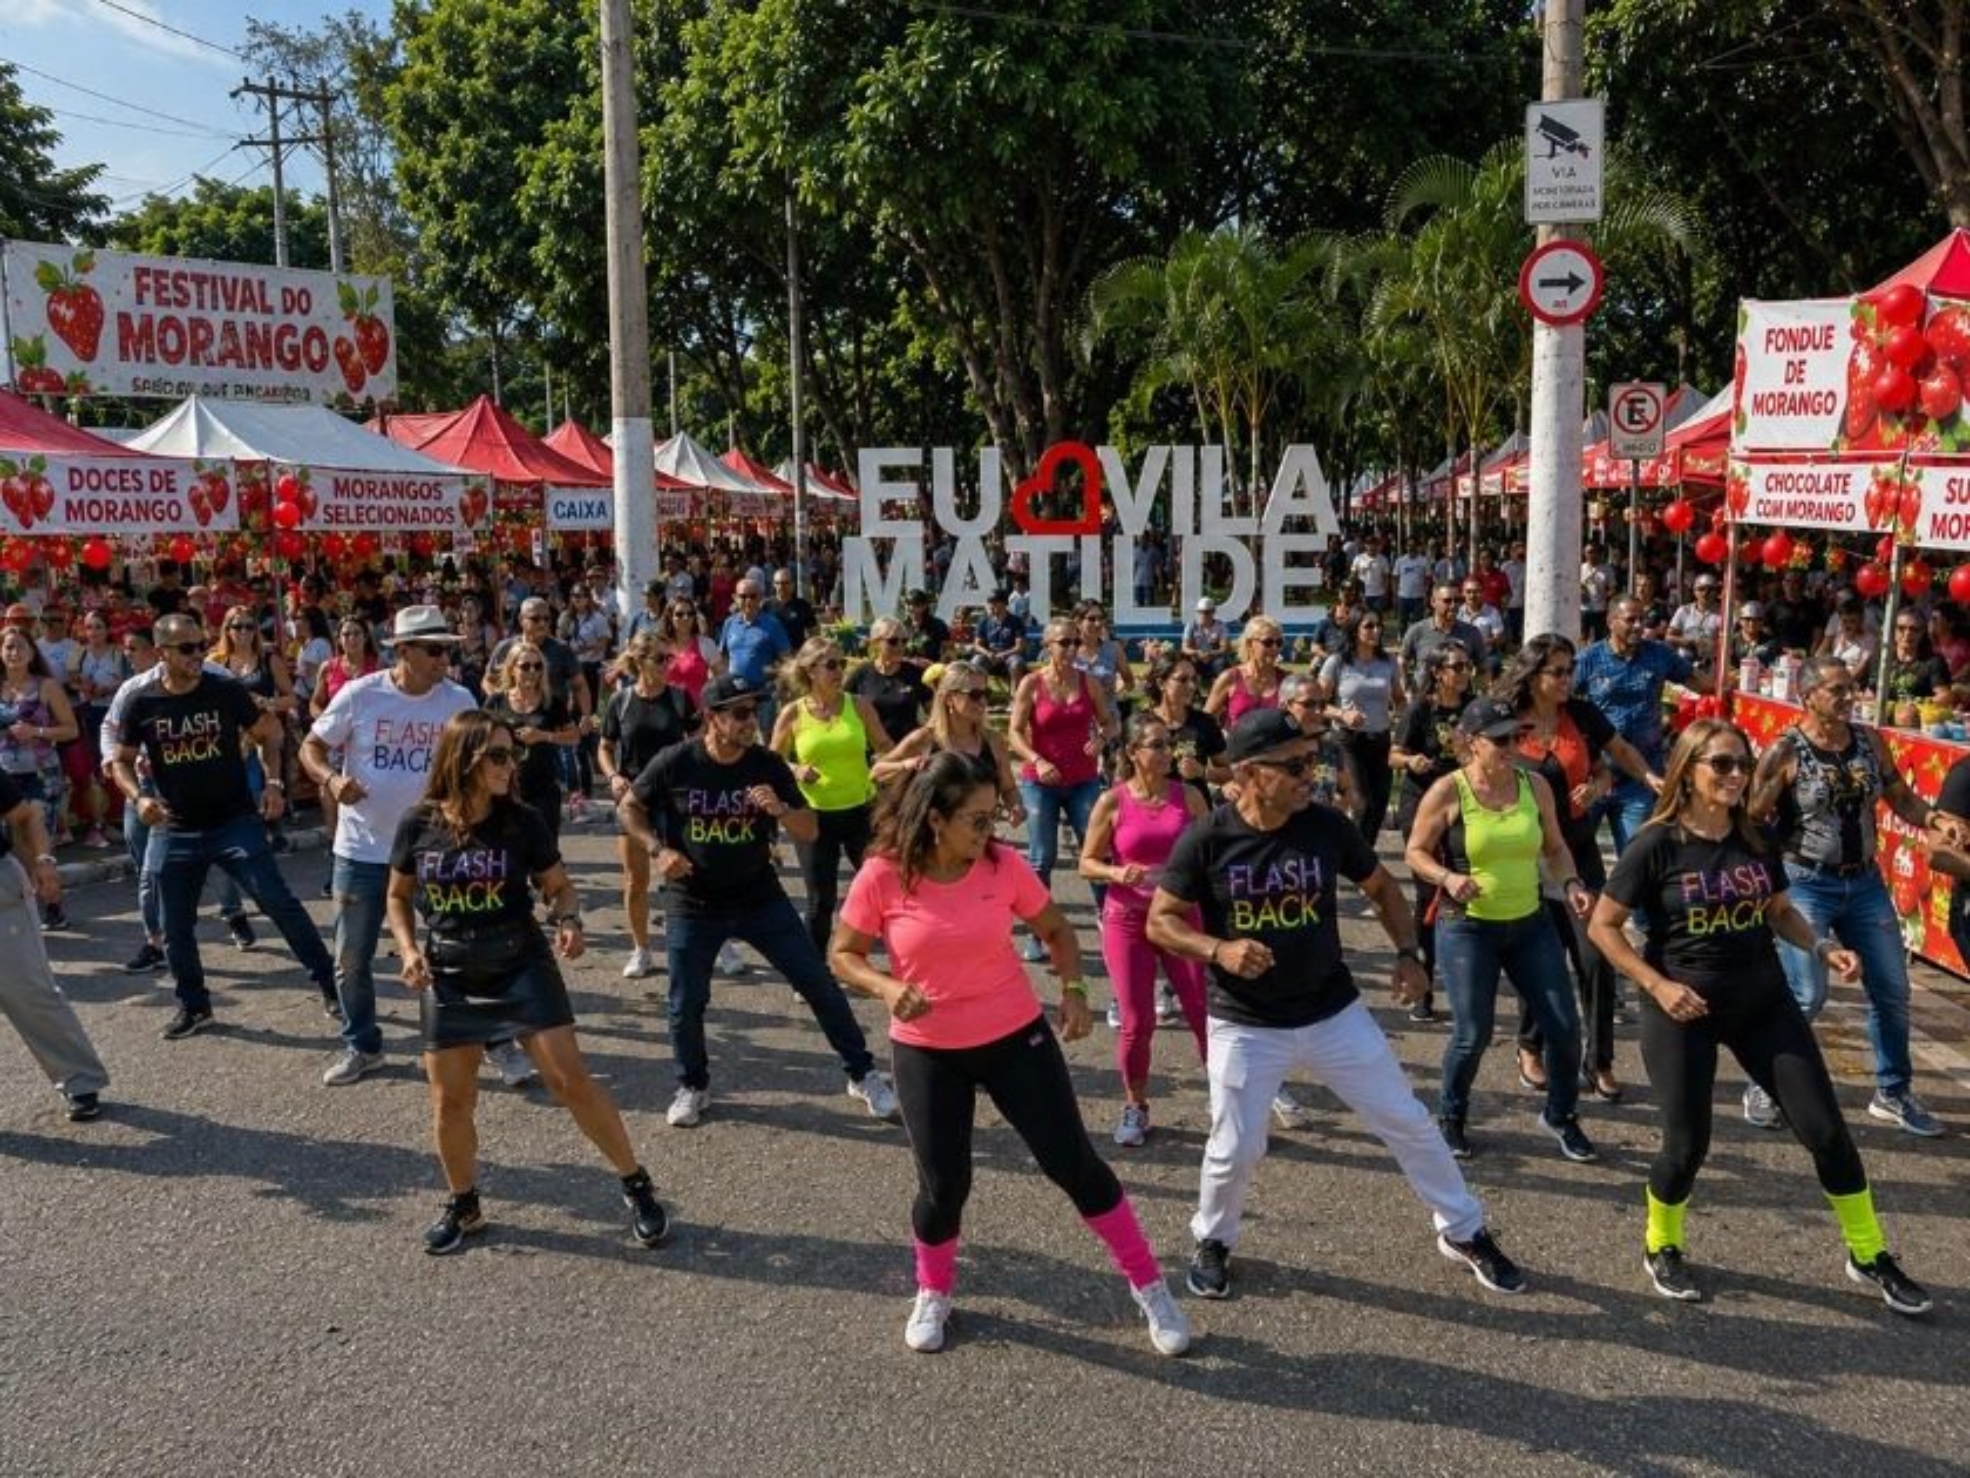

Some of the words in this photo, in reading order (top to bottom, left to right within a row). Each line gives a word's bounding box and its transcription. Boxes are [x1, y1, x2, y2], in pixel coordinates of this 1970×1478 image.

[134, 267, 274, 315] FESTIVAL
[281, 287, 312, 315] DO
[117, 312, 330, 373] MORANGO
[1765, 324, 1835, 354] FONDUE
[1784, 358, 1807, 385] DE
[1752, 390, 1837, 417] MORANGO
[69, 467, 144, 493] DOCES
[150, 469, 177, 493] DE
[334, 478, 443, 501] MORANGOS
[857, 446, 1001, 538] EU
[1097, 443, 1341, 537] VILA
[1765, 473, 1852, 495] CHOCOLATE
[65, 499, 181, 523] MORANGO
[323, 503, 456, 525] SELECIONADOS
[553, 499, 609, 519] CAIXA
[1785, 500, 1856, 523] MORANGO
[842, 533, 1329, 626] MATILDE
[155, 712, 221, 738] FLASH
[375, 718, 444, 744] FLASH
[162, 736, 221, 764] BACK
[690, 817, 755, 843] BACK
[418, 850, 507, 881] FLASH
[1229, 856, 1322, 898] FLASH
[1681, 862, 1772, 902] FLASH
[427, 881, 505, 912] BACK
[1233, 891, 1321, 930] BACK
[1687, 898, 1771, 934] BACK
